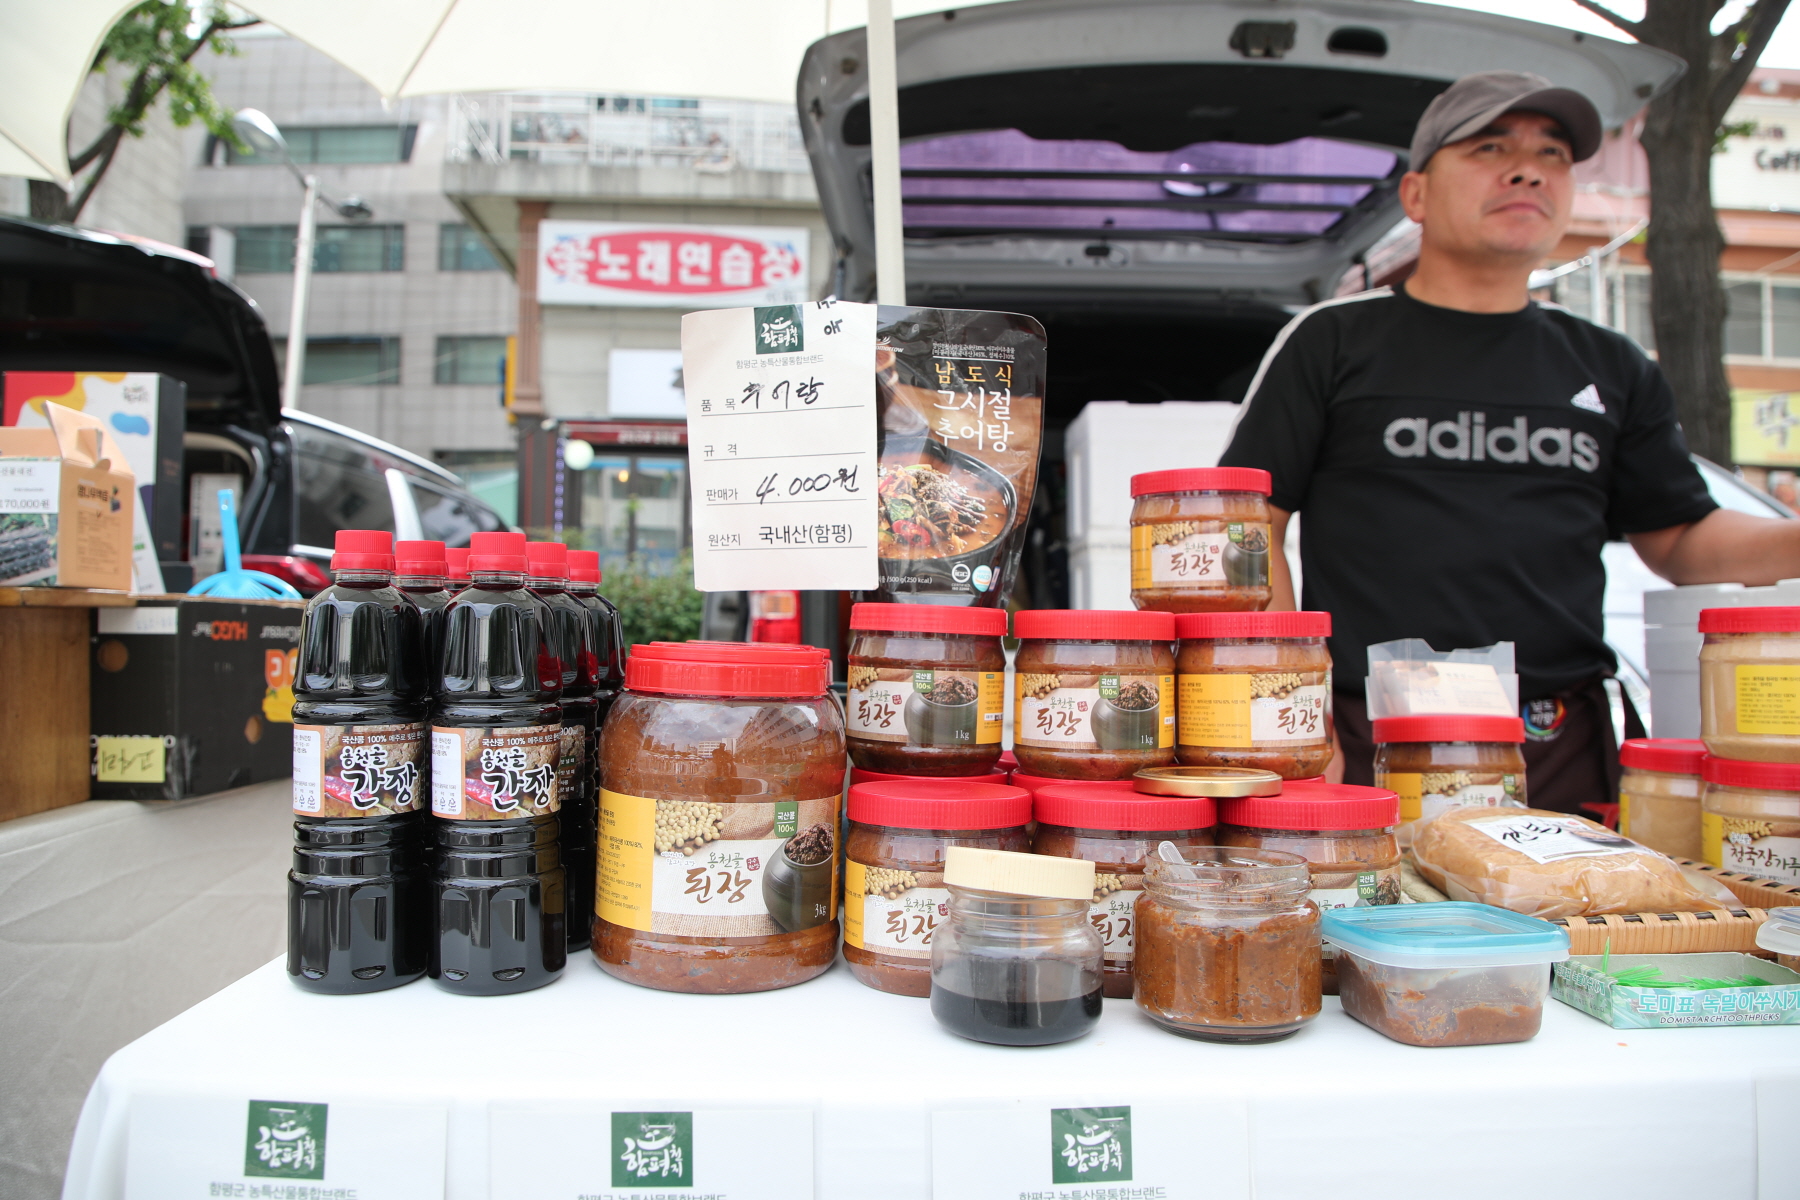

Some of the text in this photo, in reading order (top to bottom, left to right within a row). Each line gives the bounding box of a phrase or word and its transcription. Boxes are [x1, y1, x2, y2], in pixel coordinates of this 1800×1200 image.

[736, 354, 824, 370] 함평군 농특산물통합브랜드
[933, 386, 1012, 420] 그시절
[934, 417, 1015, 453] 추어탕
[1384, 411, 1600, 473] adidas
[706, 488, 739, 502] 판매가
[707, 523, 853, 547] 원산지 국내산(함평)
[1170, 552, 1214, 577] 된장
[915, 672, 932, 680] 국산콩
[1101, 678, 1118, 686] 국산콩
[915, 682, 932, 690] 100%
[1101, 688, 1118, 696] 100%
[1049, 696, 1076, 710] 용천골
[857, 699, 896, 728] 된장
[1036, 707, 1082, 736] 된장
[1277, 706, 1319, 735] 된장
[342, 735, 365, 745] 국산콩
[367, 734, 387, 744] 100%
[482, 738, 505, 748] 국산콩
[506, 737, 526, 746] 100%
[341, 744, 387, 769] 용천골
[481, 747, 526, 771] 용천골
[341, 761, 418, 810] 간장
[481, 764, 556, 812] 간장
[777, 811, 796, 821] 국산콩
[777, 823, 795, 833] 100%
[707, 852, 744, 870] 용천골
[684, 867, 752, 904] 된장
[1359, 874, 1375, 884] 국산콩
[1360, 887, 1375, 895] 100%
[904, 897, 936, 913] 용천골
[1109, 899, 1133, 915] 용천
[1638, 993, 1694, 1014] 도미표
[1659, 1012, 1781, 1025] DOMISTARCHTOOTHPICKS
[209, 1181, 245, 1197] 함평군
